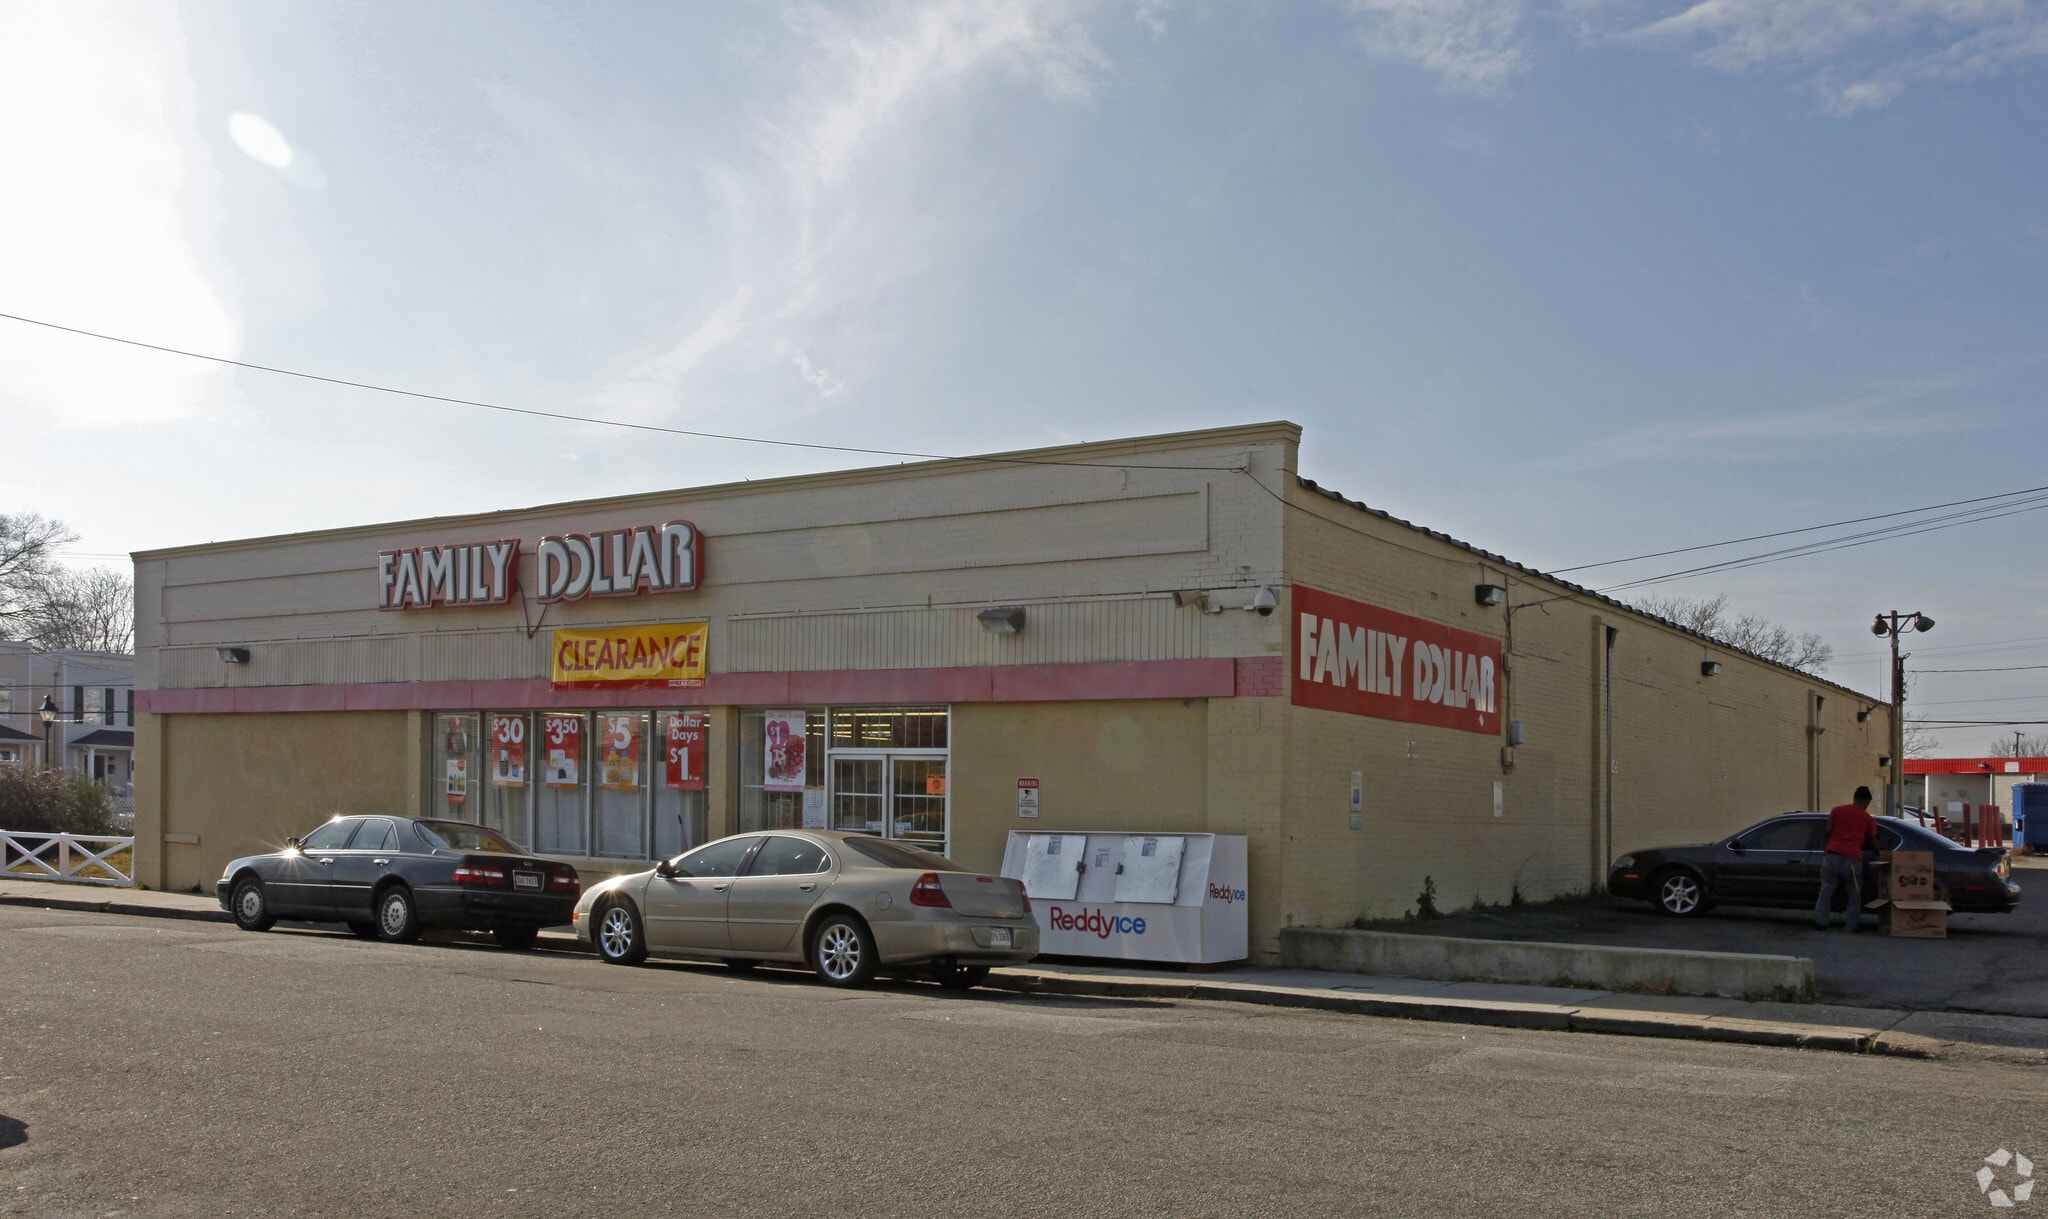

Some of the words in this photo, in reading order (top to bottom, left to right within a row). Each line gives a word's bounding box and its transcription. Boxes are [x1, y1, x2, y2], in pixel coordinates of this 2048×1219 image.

[378, 541, 513, 608] FAMILY
[537, 522, 695, 600] DOLLAR
[558, 634, 701, 672] CLEARANCE
[1300, 612, 1407, 697] FAMILY
[1413, 640, 1496, 714] DOLLAR
[493, 717, 524, 744] $30
[608, 717, 632, 750] $5
[670, 715, 701, 727] Dollar
[672, 729, 698, 743] Days
[770, 725, 781, 746] $1
[670, 747, 688, 780] $1
